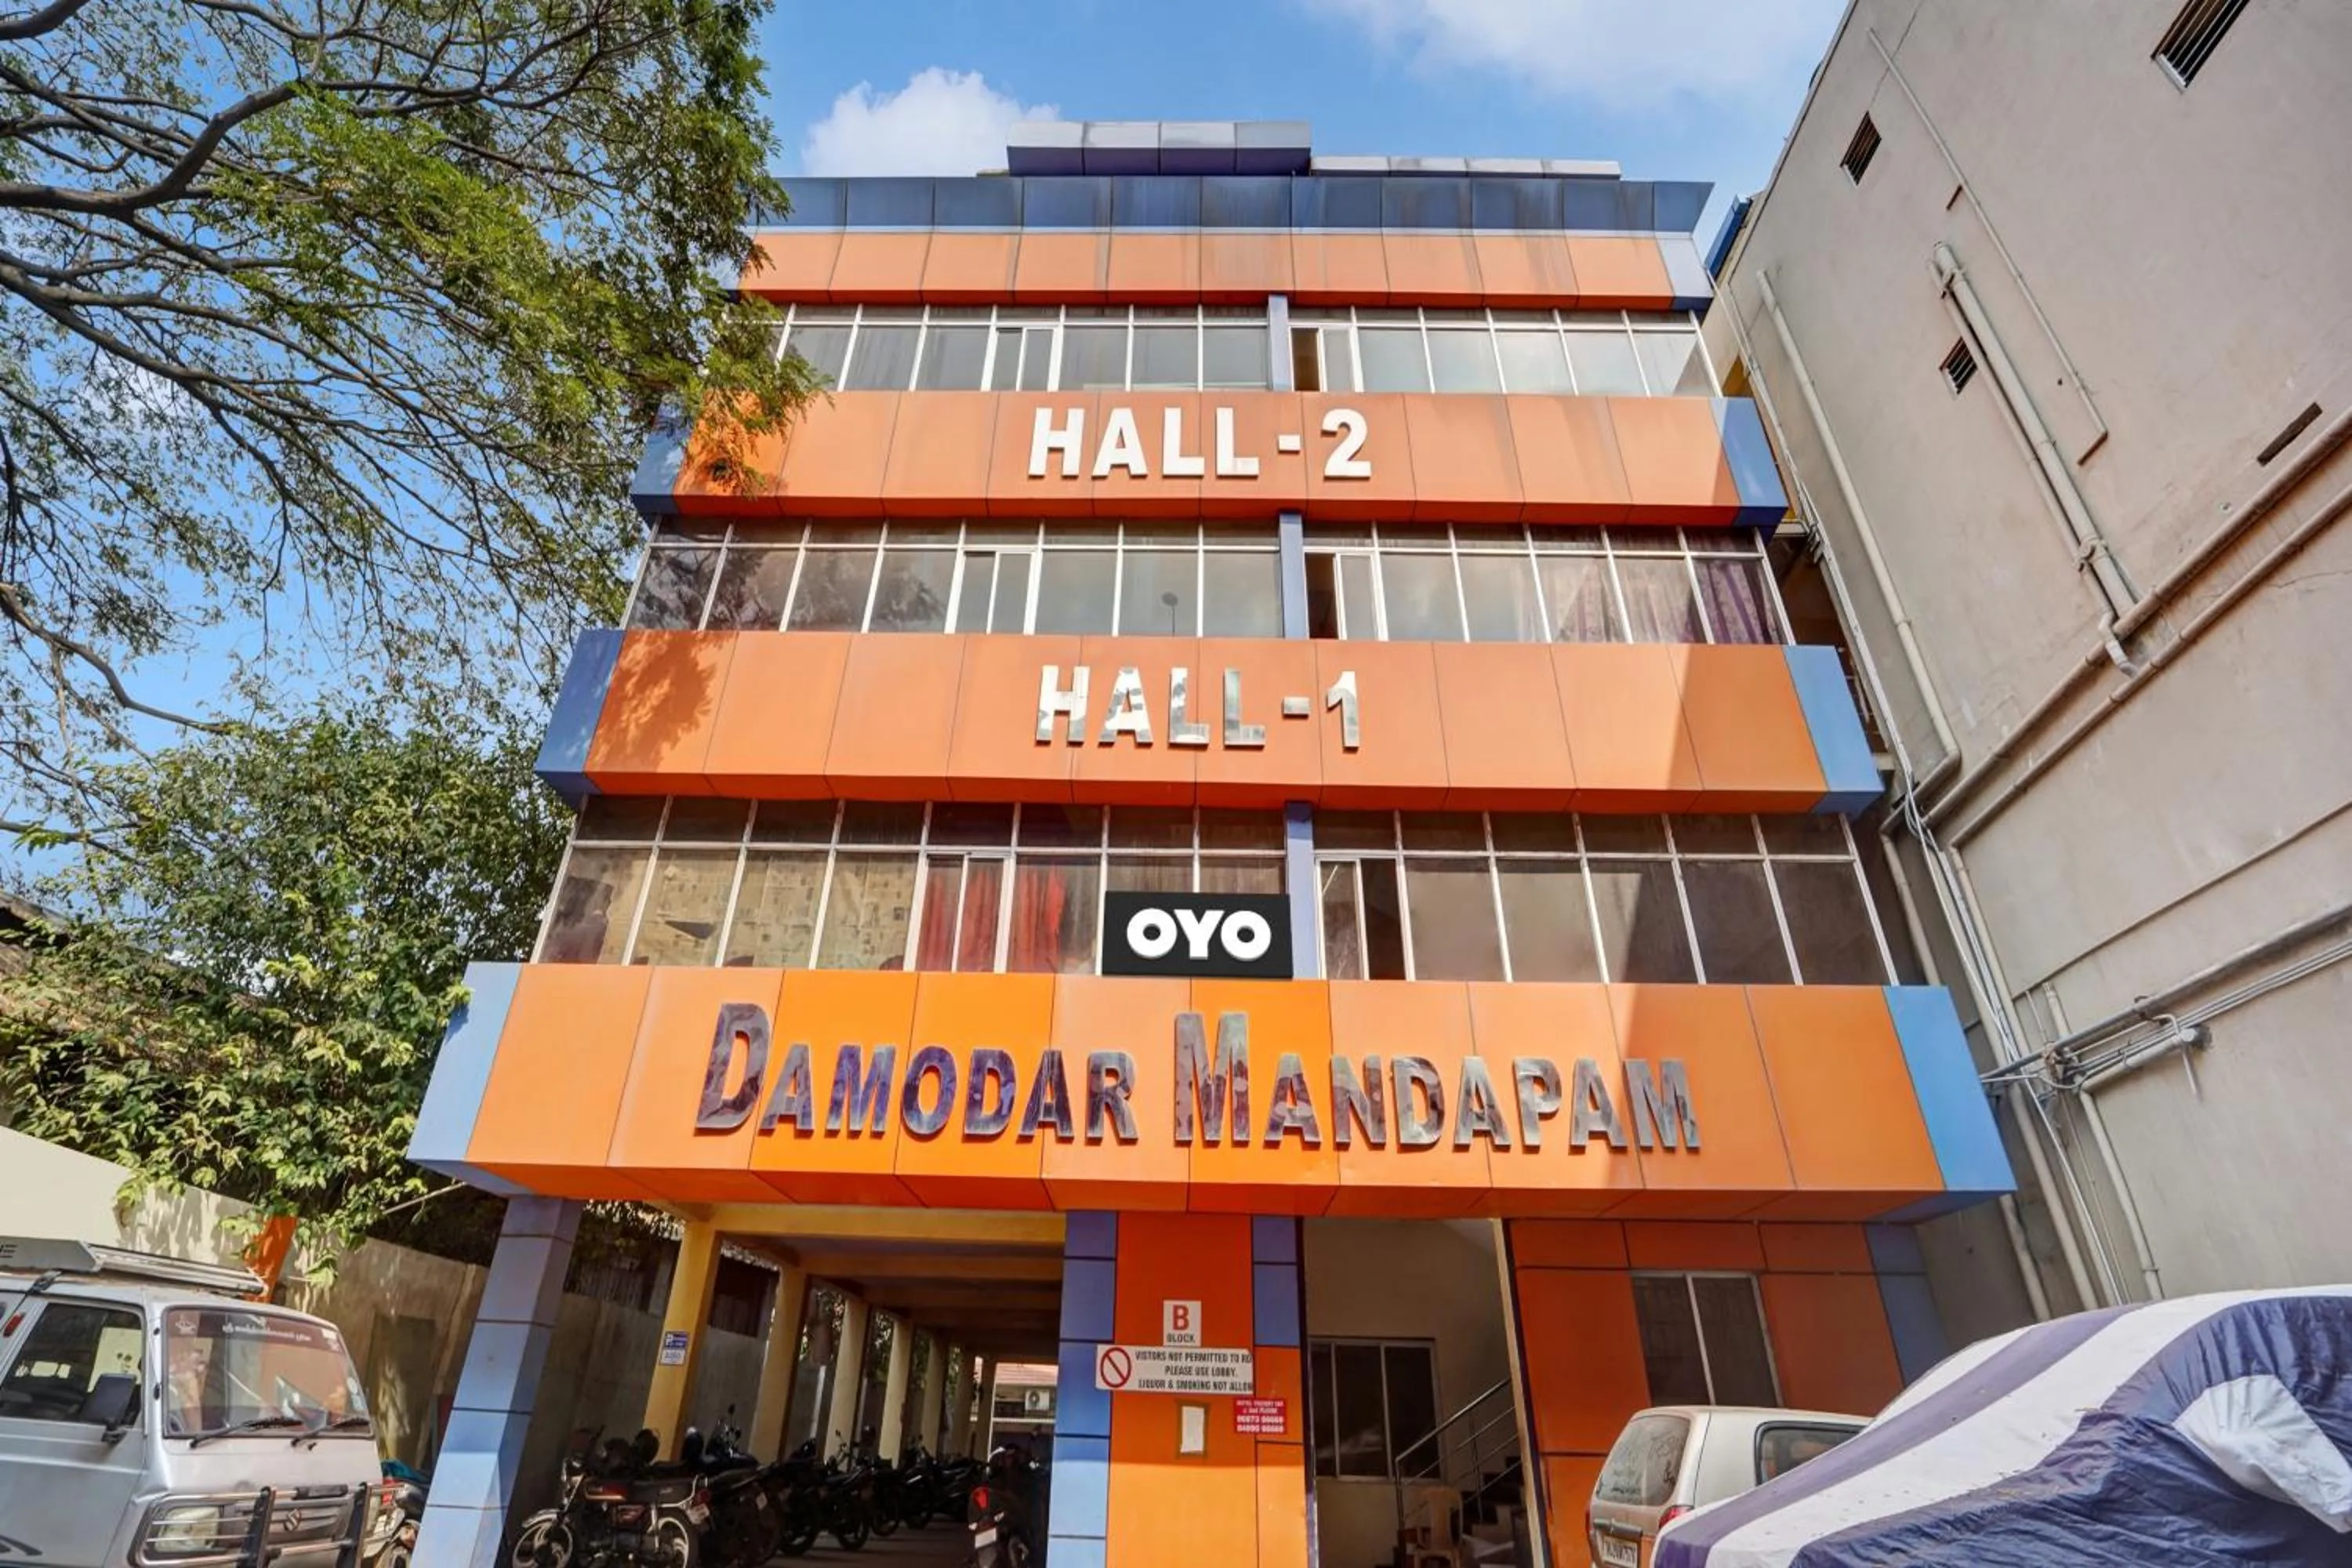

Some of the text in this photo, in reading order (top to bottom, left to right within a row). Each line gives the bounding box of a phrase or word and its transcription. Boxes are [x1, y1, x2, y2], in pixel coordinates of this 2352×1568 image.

[1029, 407, 1260, 477] HALL
[1321, 408, 1372, 479] 2
[1036, 664, 1266, 748] HALL
[1327, 670, 1360, 750] 1
[1127, 907, 1272, 962] OYO
[1172, 1304, 1189, 1330] B
[1166, 1333, 1196, 1344] BLOCK
[1167, 1351, 1183, 1363] NOT
[1184, 1352, 1229, 1363] PERMITTED
[1230, 1353, 1239, 1363] TO
[1165, 1365, 1193, 1376] PLEASE
[1195, 1367, 1210, 1377] USE
[1138, 1379, 1166, 1389] LIQUOR
[1167, 1379, 1174, 1389] &
[1176, 1380, 1210, 1391] SMOKING
[1213, 1381, 1227, 1392] NOT
